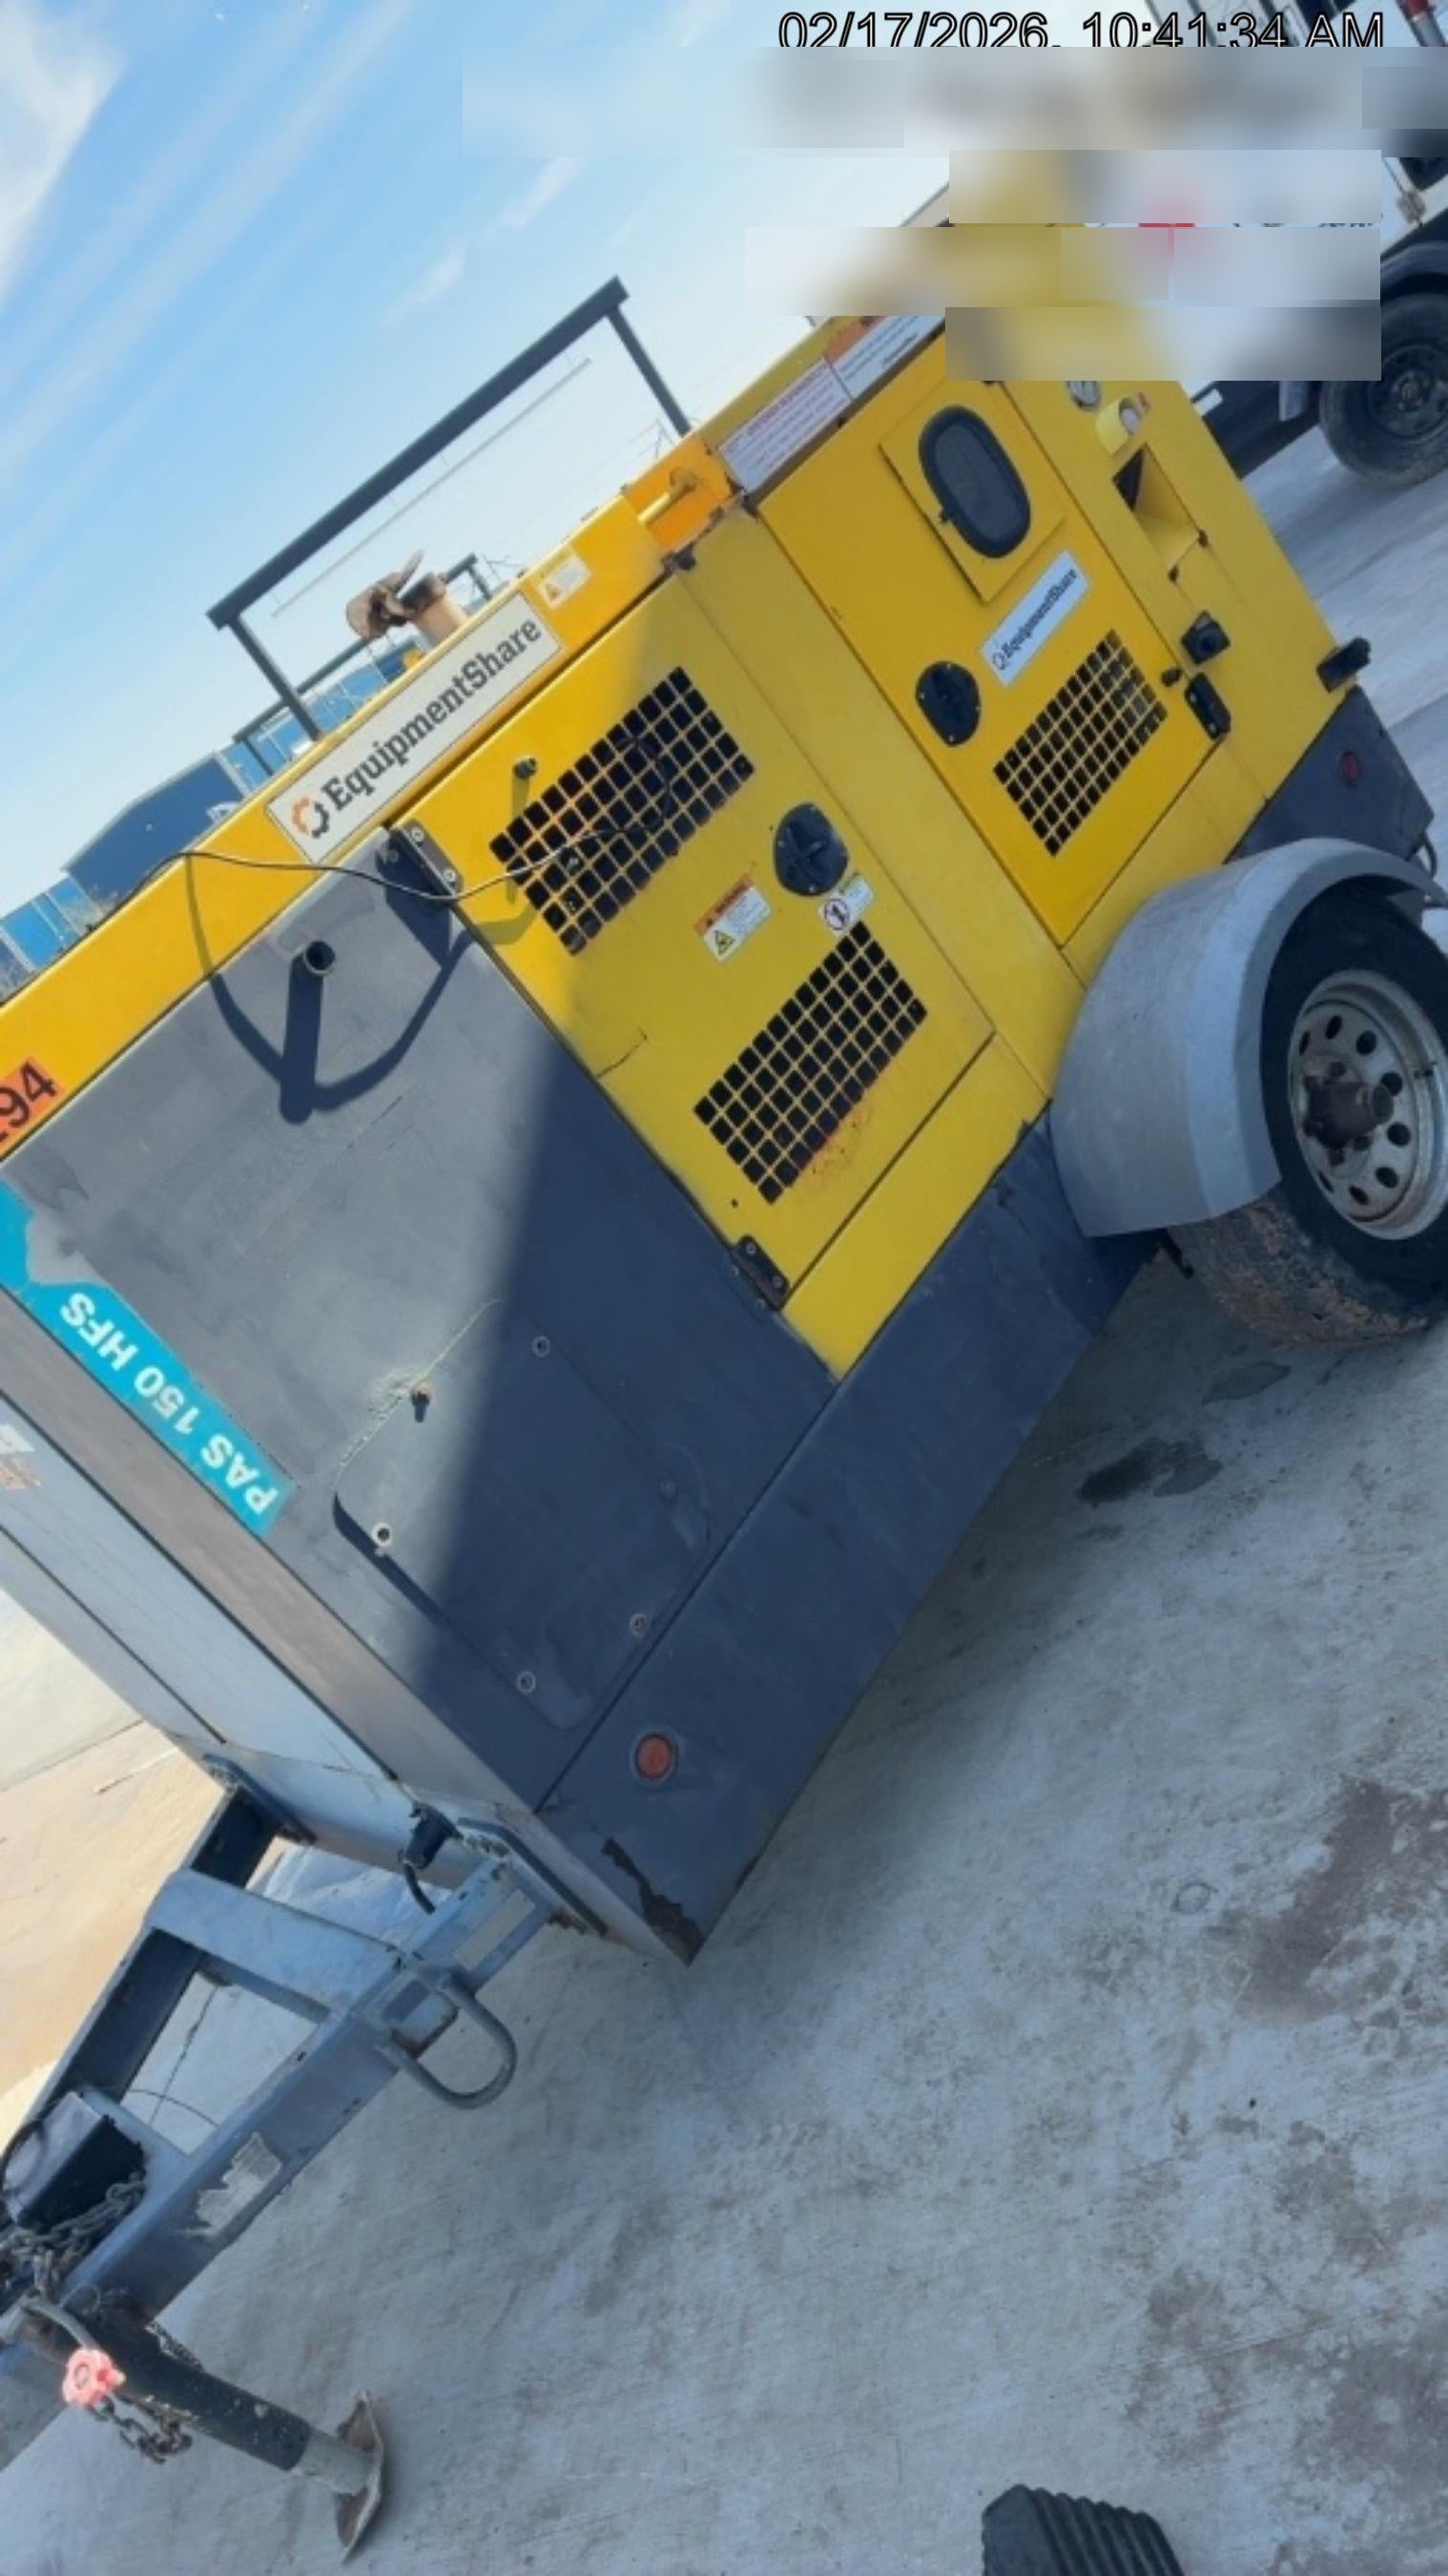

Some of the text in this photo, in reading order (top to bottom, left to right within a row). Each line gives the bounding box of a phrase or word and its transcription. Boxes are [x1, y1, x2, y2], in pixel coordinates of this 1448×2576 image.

[321, 616, 542, 815] EquipmentShare
[0, 1062, 56, 1139] 94
[59, 1292, 279, 1515] PAS 150 HFS
